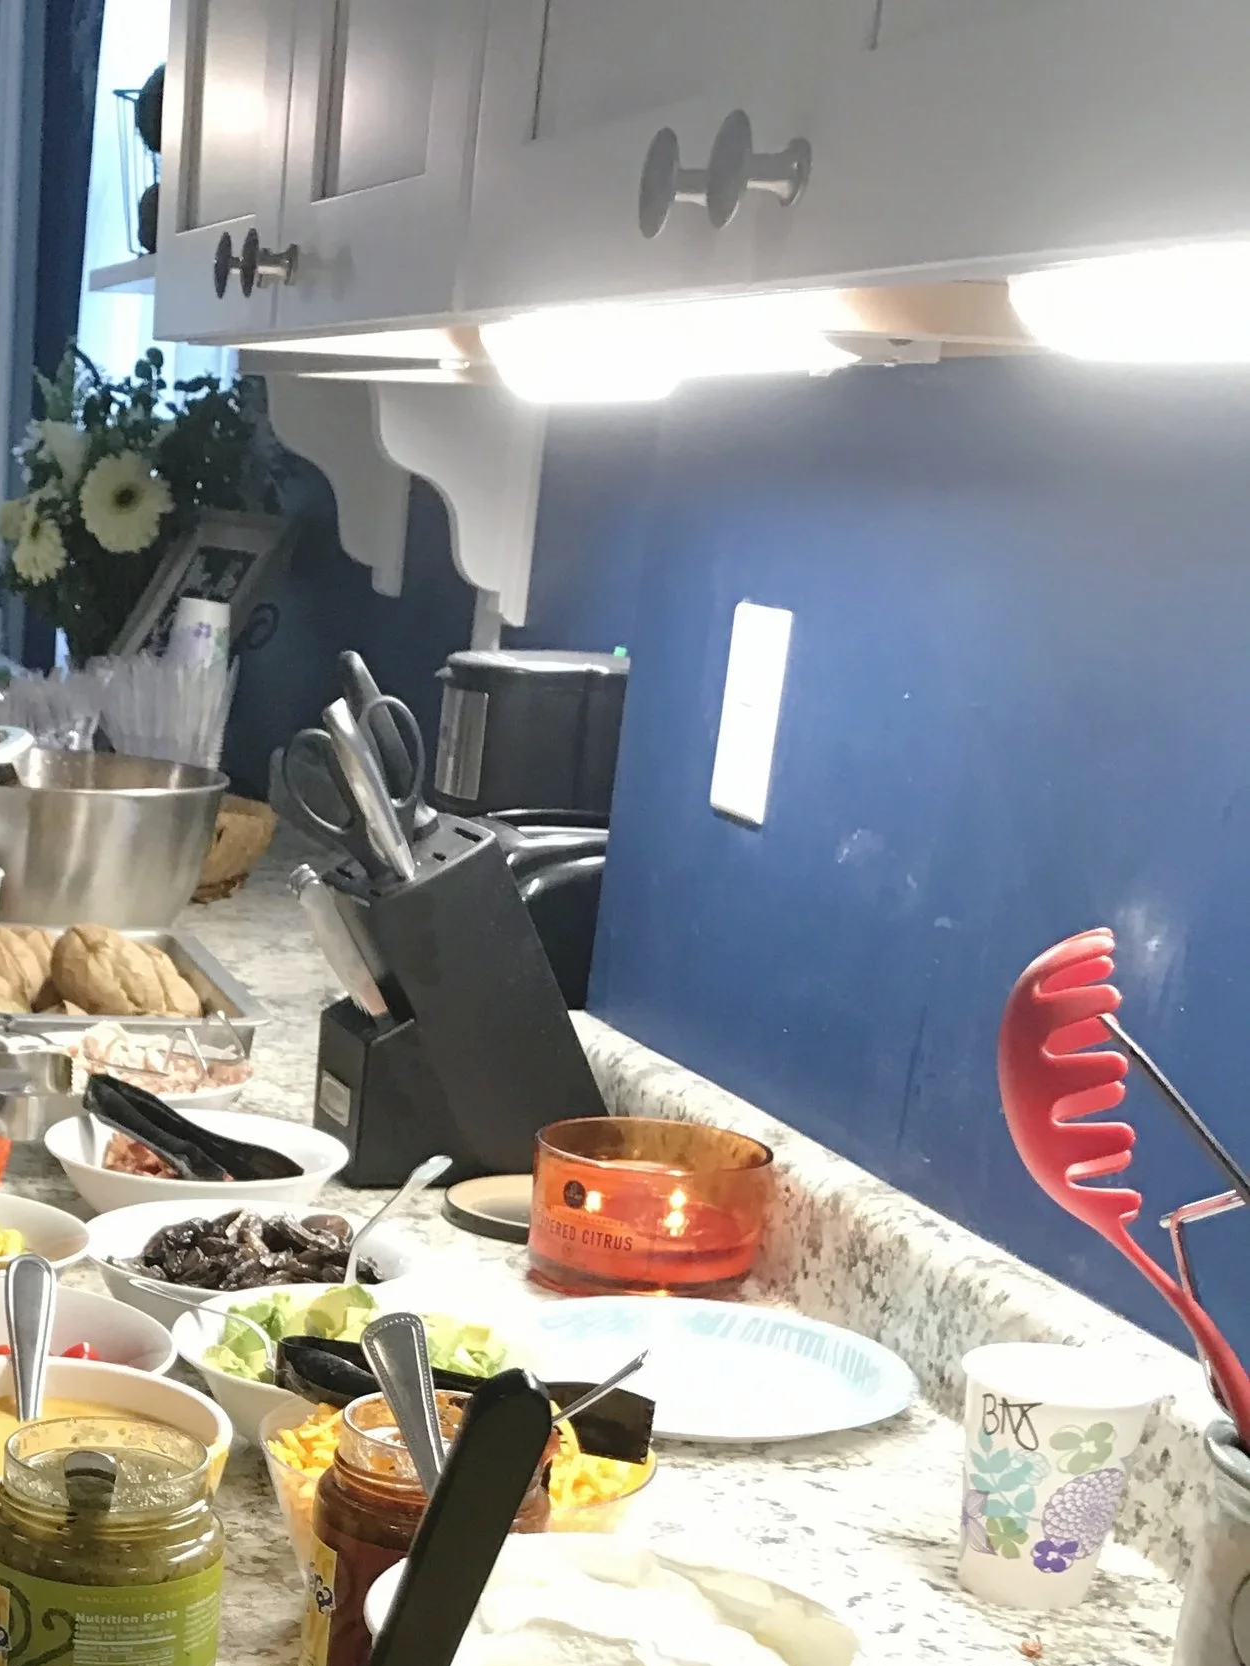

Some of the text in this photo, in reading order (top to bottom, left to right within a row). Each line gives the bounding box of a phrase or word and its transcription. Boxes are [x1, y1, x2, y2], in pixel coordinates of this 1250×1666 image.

[582, 1229, 633, 1251] CITRUS
[75, 1610, 178, 1624] Nutrition Facts
